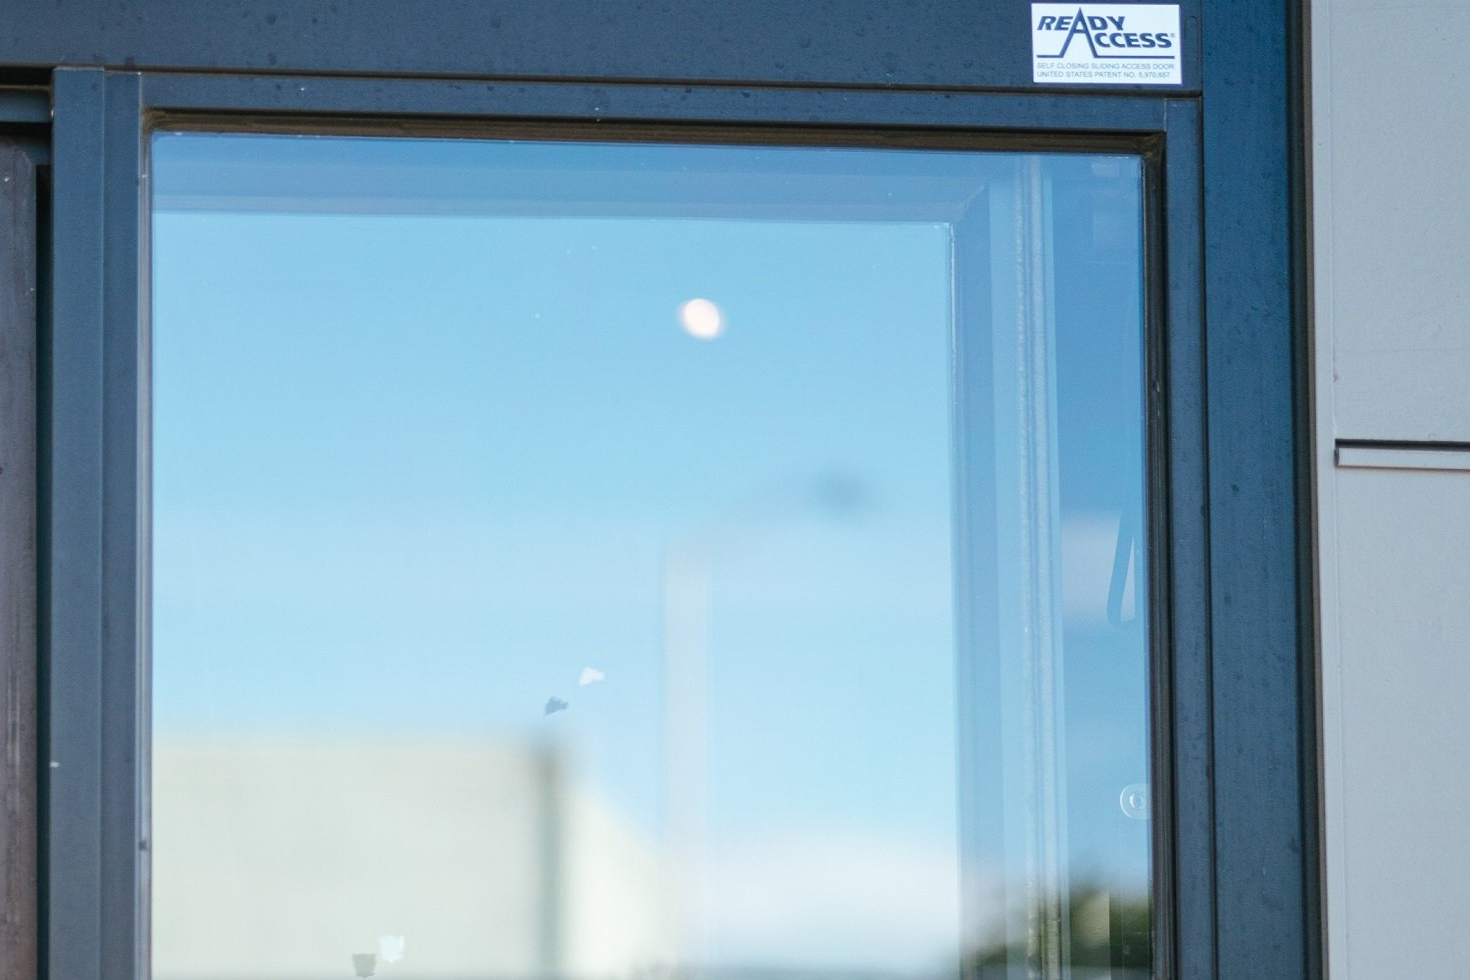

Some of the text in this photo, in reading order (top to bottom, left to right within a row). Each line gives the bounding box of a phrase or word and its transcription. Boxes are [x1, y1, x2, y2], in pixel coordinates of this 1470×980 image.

[1036, 62, 1055, 70] SELF
[1056, 62, 1089, 70] CLOSING
[1091, 62, 1120, 70] SLIDING
